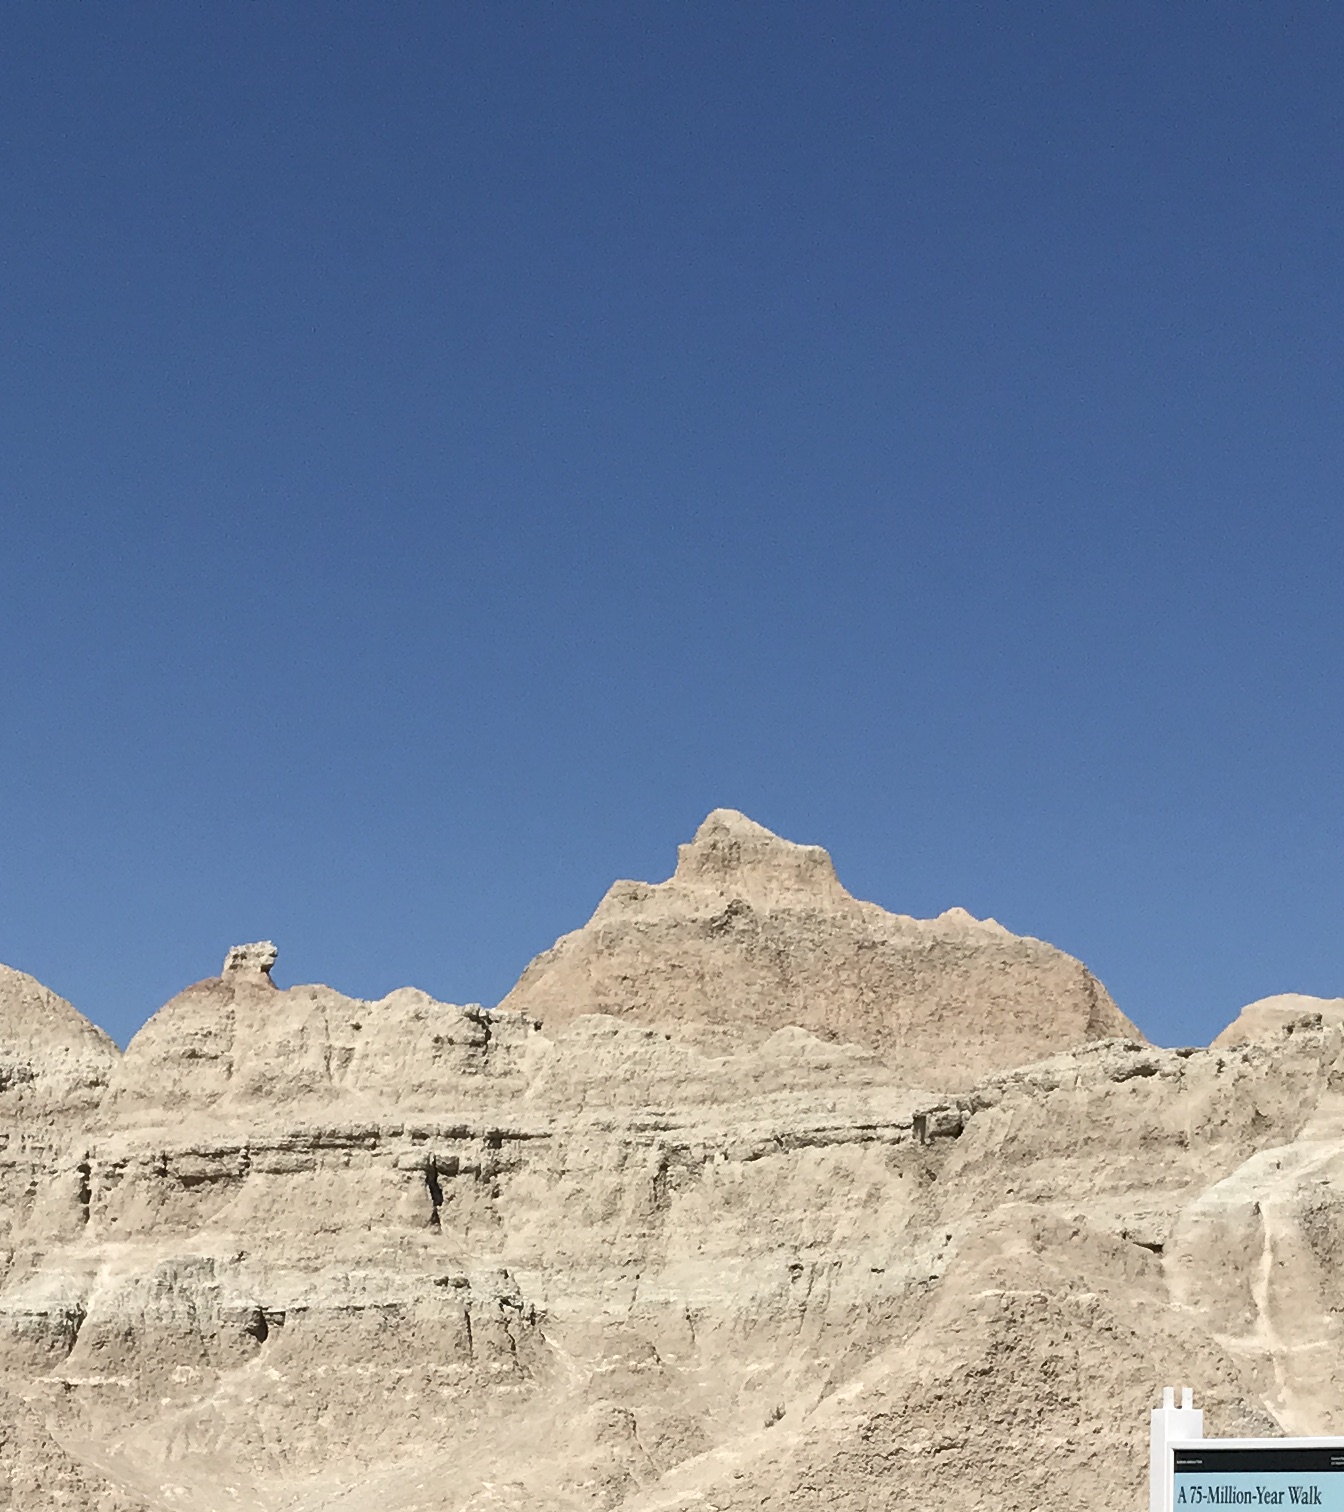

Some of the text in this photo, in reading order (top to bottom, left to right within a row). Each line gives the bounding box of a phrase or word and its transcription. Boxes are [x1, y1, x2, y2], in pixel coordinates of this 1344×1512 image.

[1177, 1485, 1322, 1505] A 75-Million-Year Walk
